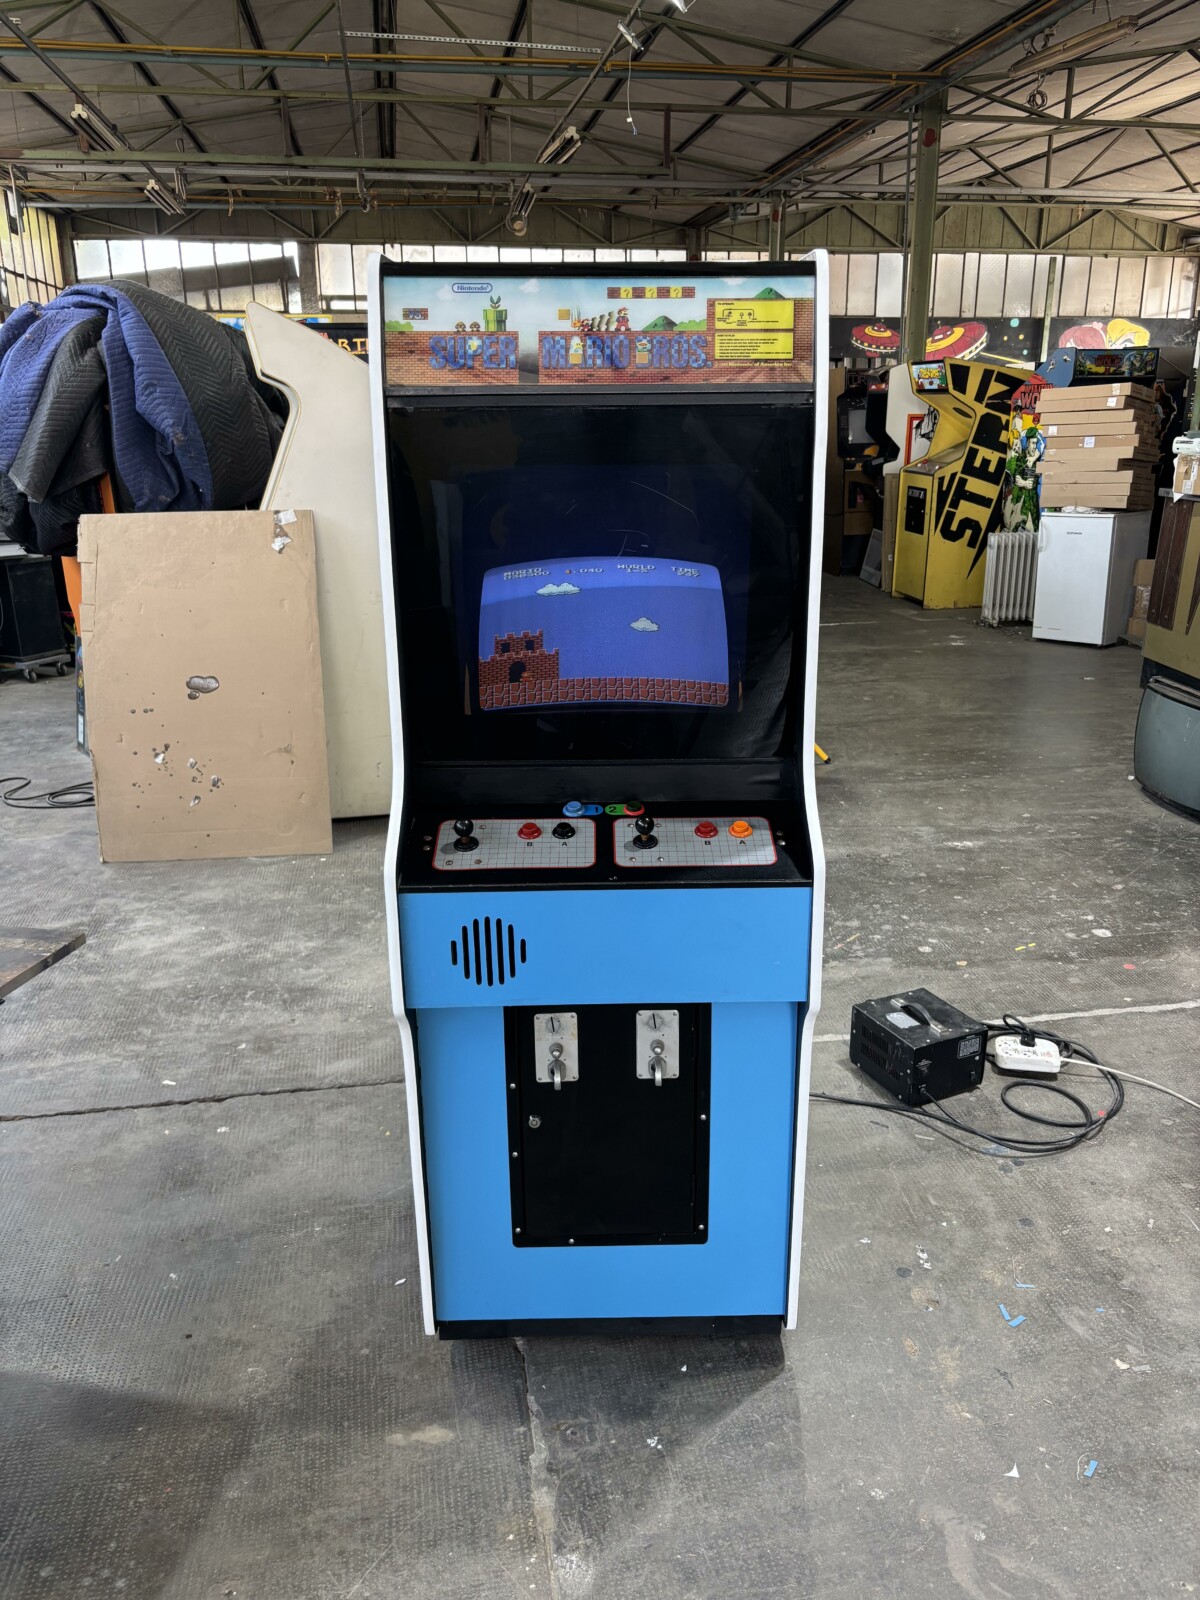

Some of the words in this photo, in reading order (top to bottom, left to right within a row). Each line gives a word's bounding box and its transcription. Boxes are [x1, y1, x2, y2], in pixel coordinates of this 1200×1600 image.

[428, 335, 517, 370] SUPER
[541, 335, 630, 370] MARIO
[635, 334, 713, 369] BROS.
[1021, 392, 1039, 409] WO
[940, 368, 1026, 549] STERN
